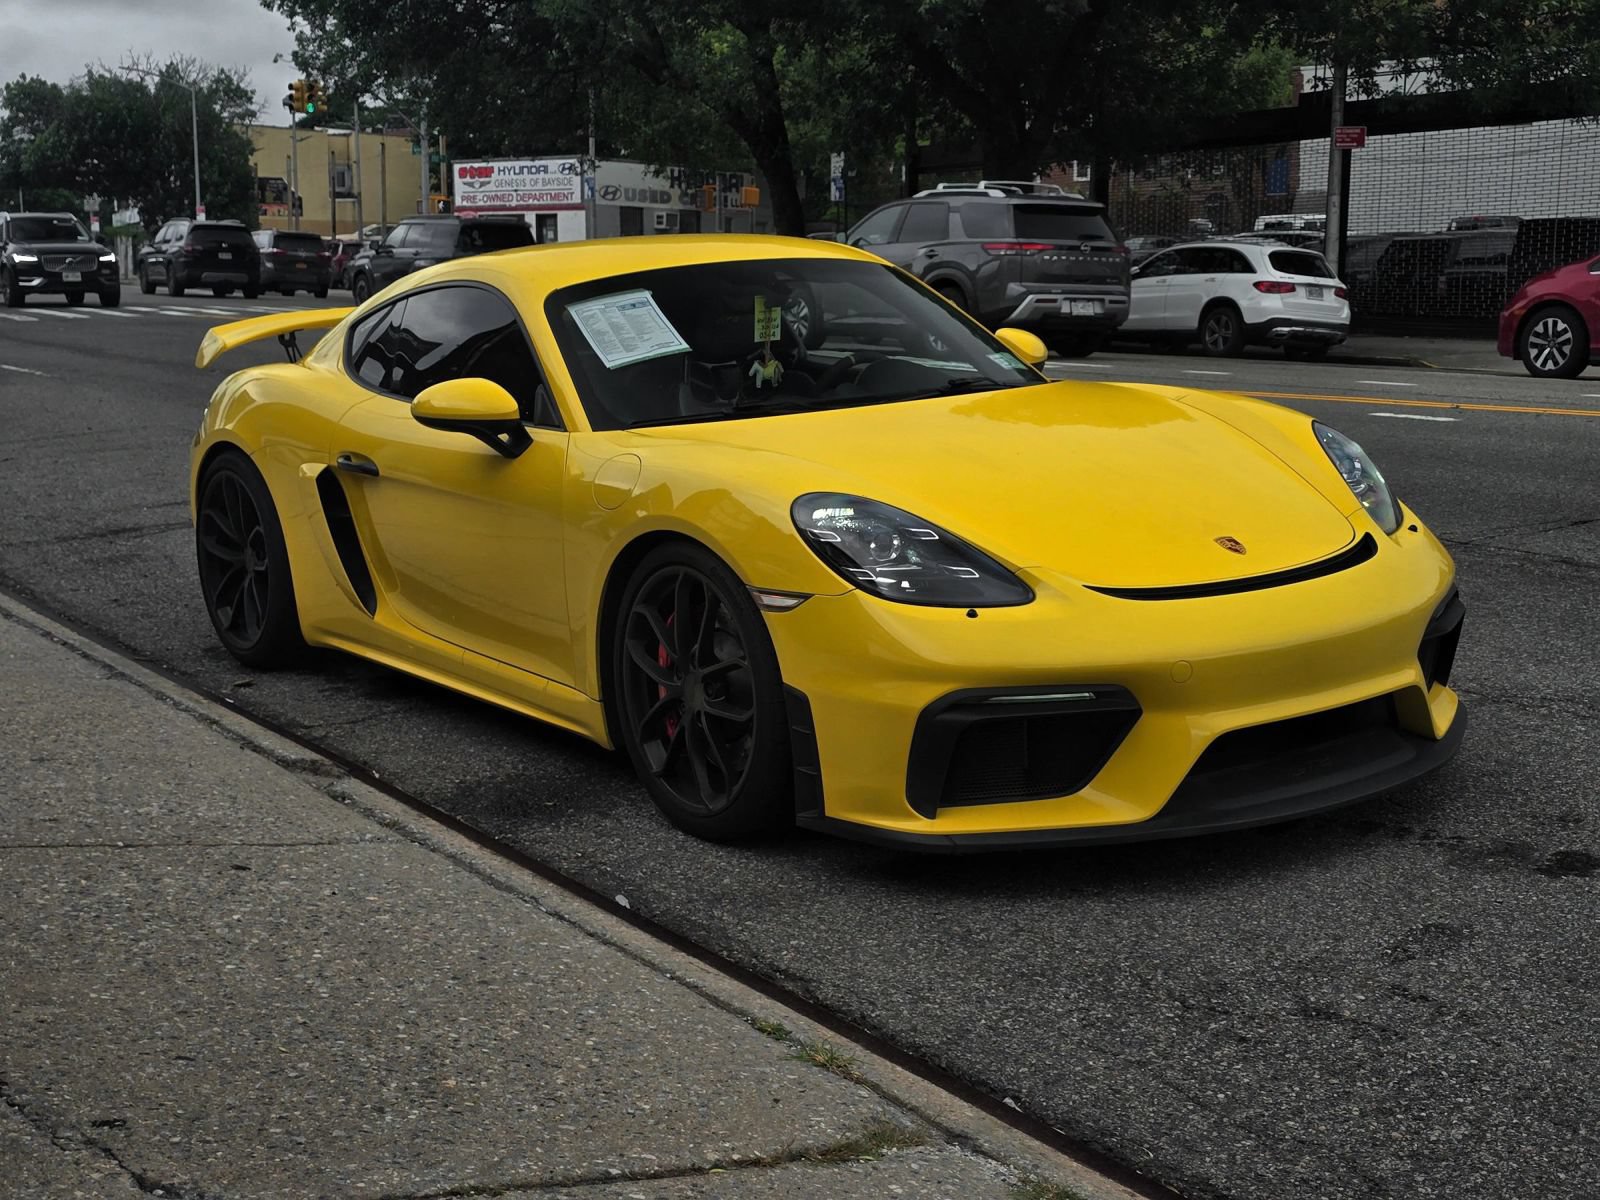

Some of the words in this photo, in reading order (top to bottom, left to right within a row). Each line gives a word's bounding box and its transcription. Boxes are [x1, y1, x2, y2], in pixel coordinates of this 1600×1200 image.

[497, 165, 549, 176] HYUNDAI
[494, 178, 527, 189] GENESIS
[530, 178, 541, 188] OF
[541, 177, 573, 187] BAYSIDE
[461, 193, 514, 204] PRE-OWNED
[515, 191, 575, 203] DEPARTMENT
[623, 187, 673, 204] USED
